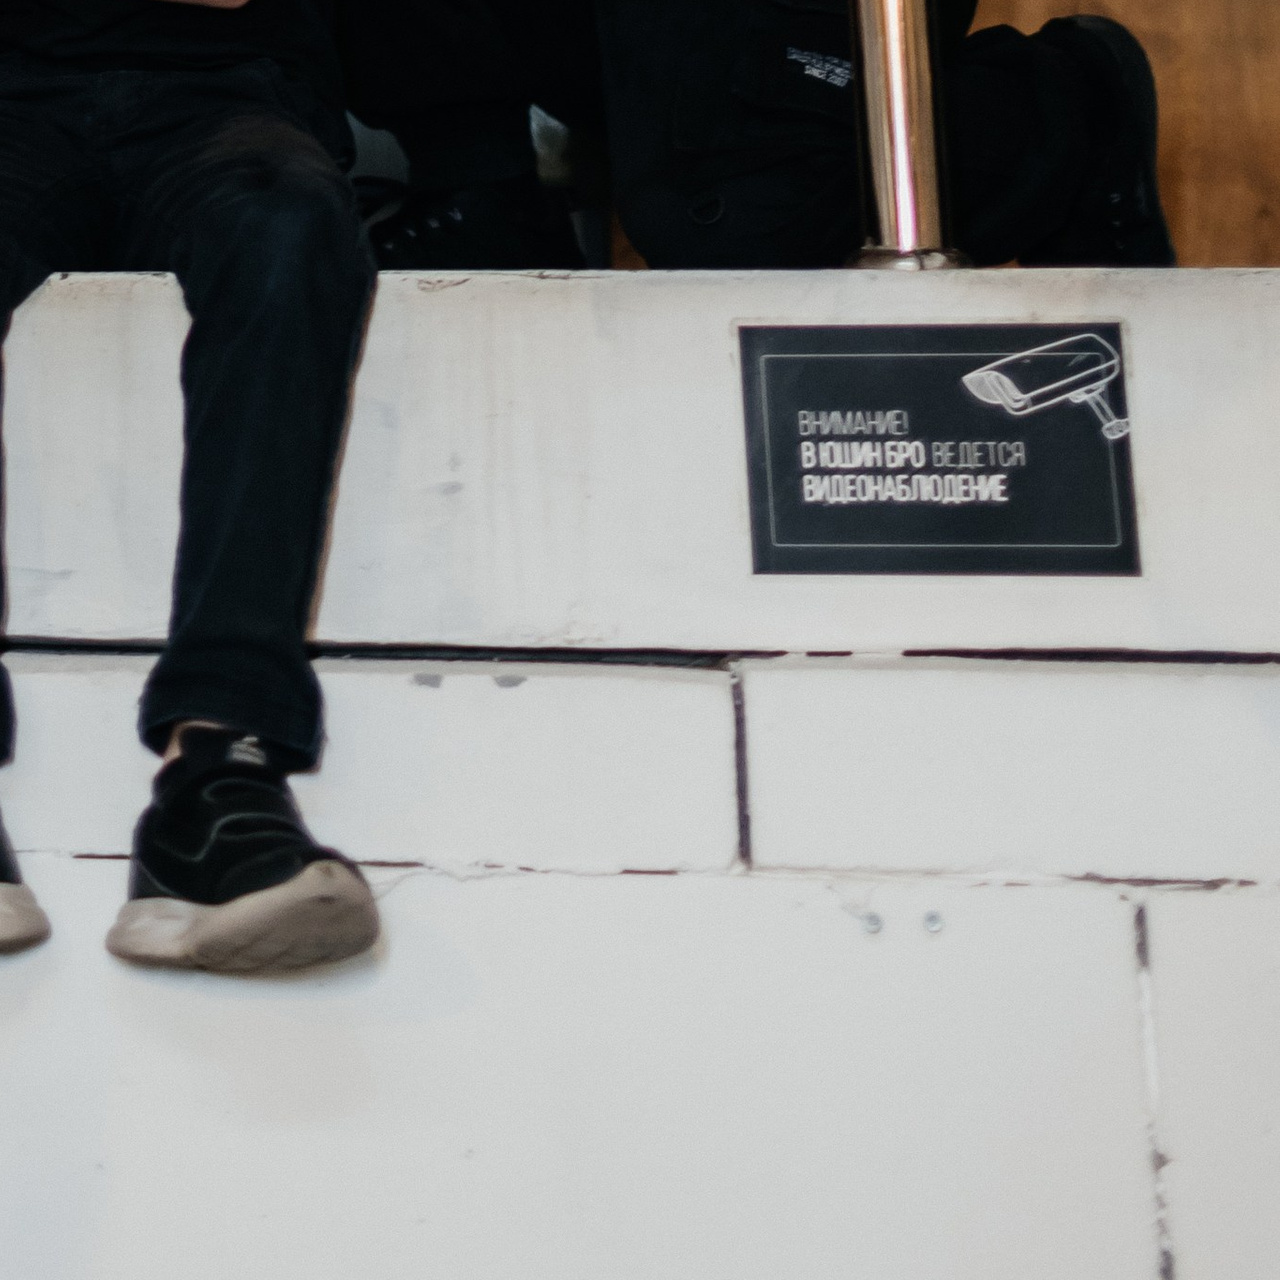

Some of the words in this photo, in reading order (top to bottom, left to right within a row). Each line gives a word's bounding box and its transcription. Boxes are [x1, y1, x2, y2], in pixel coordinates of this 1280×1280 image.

[884, 441, 927, 469] БРО
[931, 441, 1027, 469] ВЕДЕТСЯ
[802, 474, 1010, 504] ВИДЕОНАБЛЮДЕНИЕ
